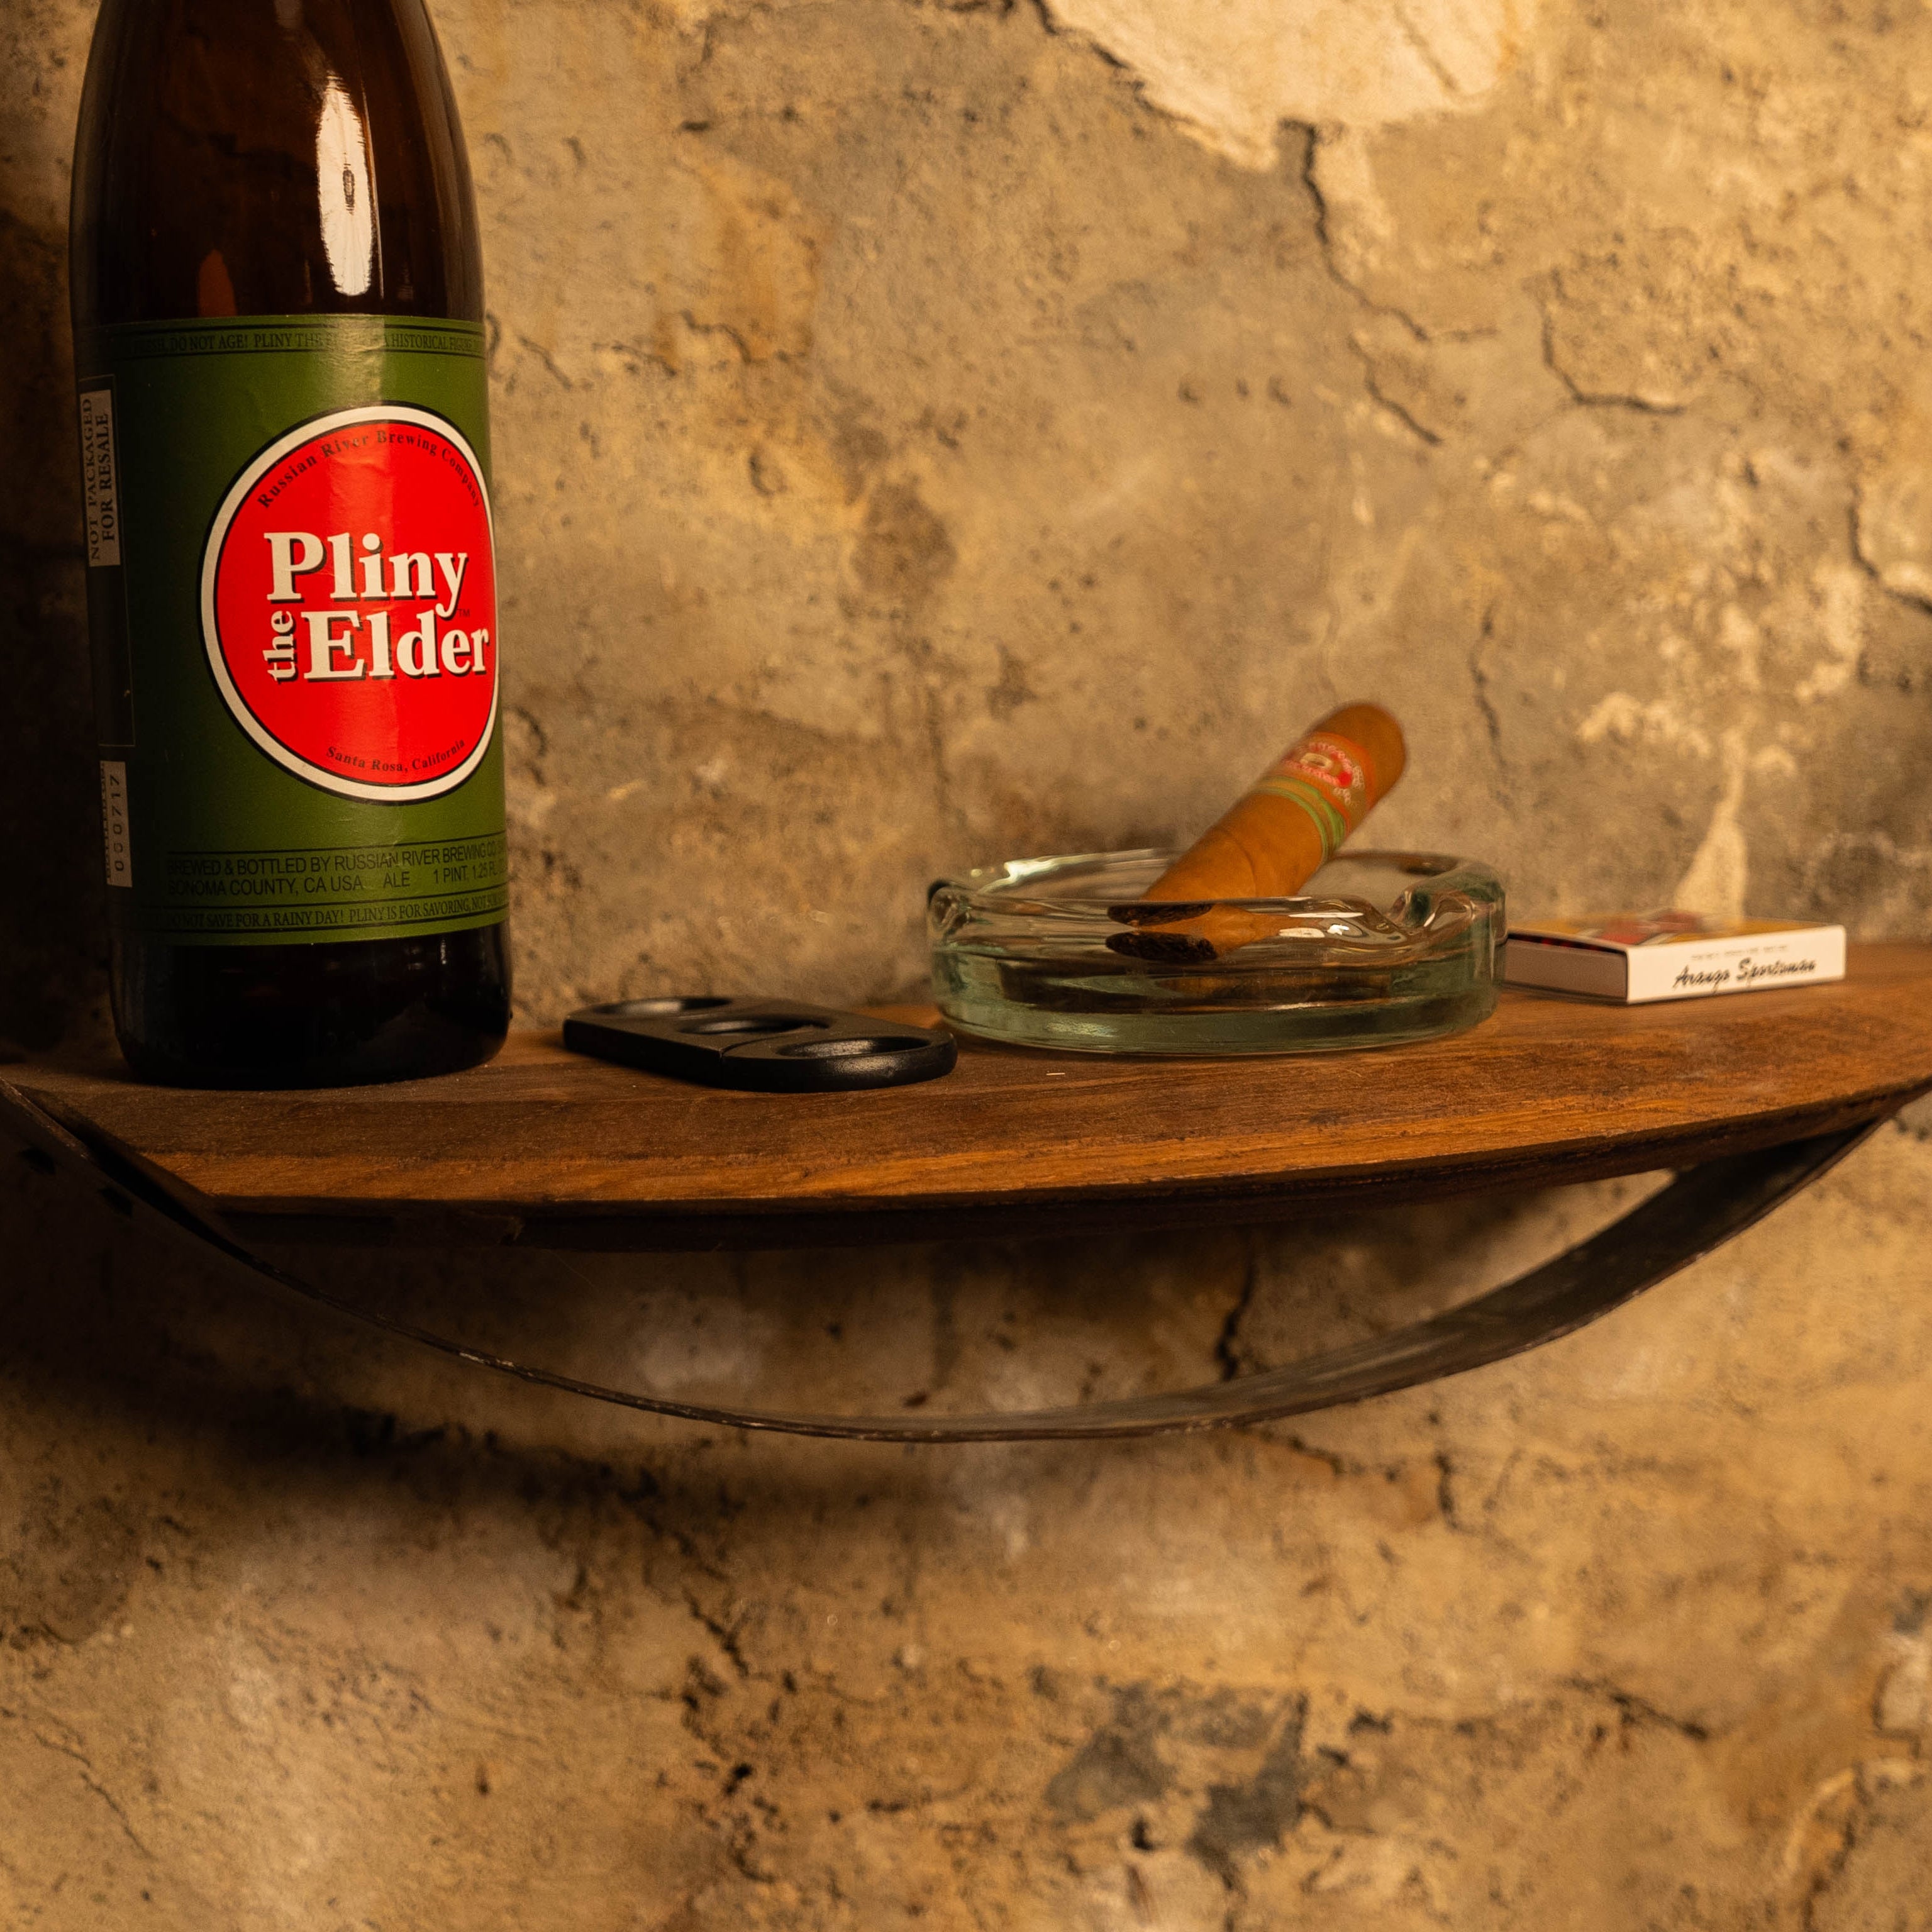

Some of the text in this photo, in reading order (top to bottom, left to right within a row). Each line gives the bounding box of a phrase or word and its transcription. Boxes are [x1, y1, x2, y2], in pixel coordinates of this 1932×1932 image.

[170, 336, 187, 352] DO
[189, 336, 214, 351] NOT
[218, 334, 248, 349] AGE!
[254, 333, 293, 348] PLINY
[295, 332, 323, 347] THE
[392, 333, 449, 350] HISTORICAL
[82, 399, 100, 561] NOT PACKAGED
[94, 413, 115, 541] FOR RESALE
[257, 430, 481, 508] Russian River Brewing Company
[264, 531, 469, 621] Pliny
[262, 609, 490, 685] the Elder
[326, 739, 465, 772] Santa Rosa, California
[167, 859, 221, 875] BREWED
[224, 859, 235, 875] &
[237, 857, 307, 875] BOTTLED
[310, 856, 331, 873] BY
[335, 852, 399, 871] RUSSIAN
[401, 848, 441, 866] RIVER
[442, 842, 487, 863] BREWING
[168, 874, 364, 896] SONOMA COUNTY, CA USA
[383, 871, 411, 888] ALE
[433, 869, 439, 884] 1
[207, 913, 233, 928] SAVE
[235, 912, 260, 927] FOR
[262, 912, 273, 927] A
[274, 910, 313, 927] RAINY
[315, 909, 344, 925] DAY!
[350, 906, 385, 923] PLINY
[387, 904, 397, 920] IS
[399, 903, 421, 919] FOR
[423, 897, 471, 918] SAVORING,
